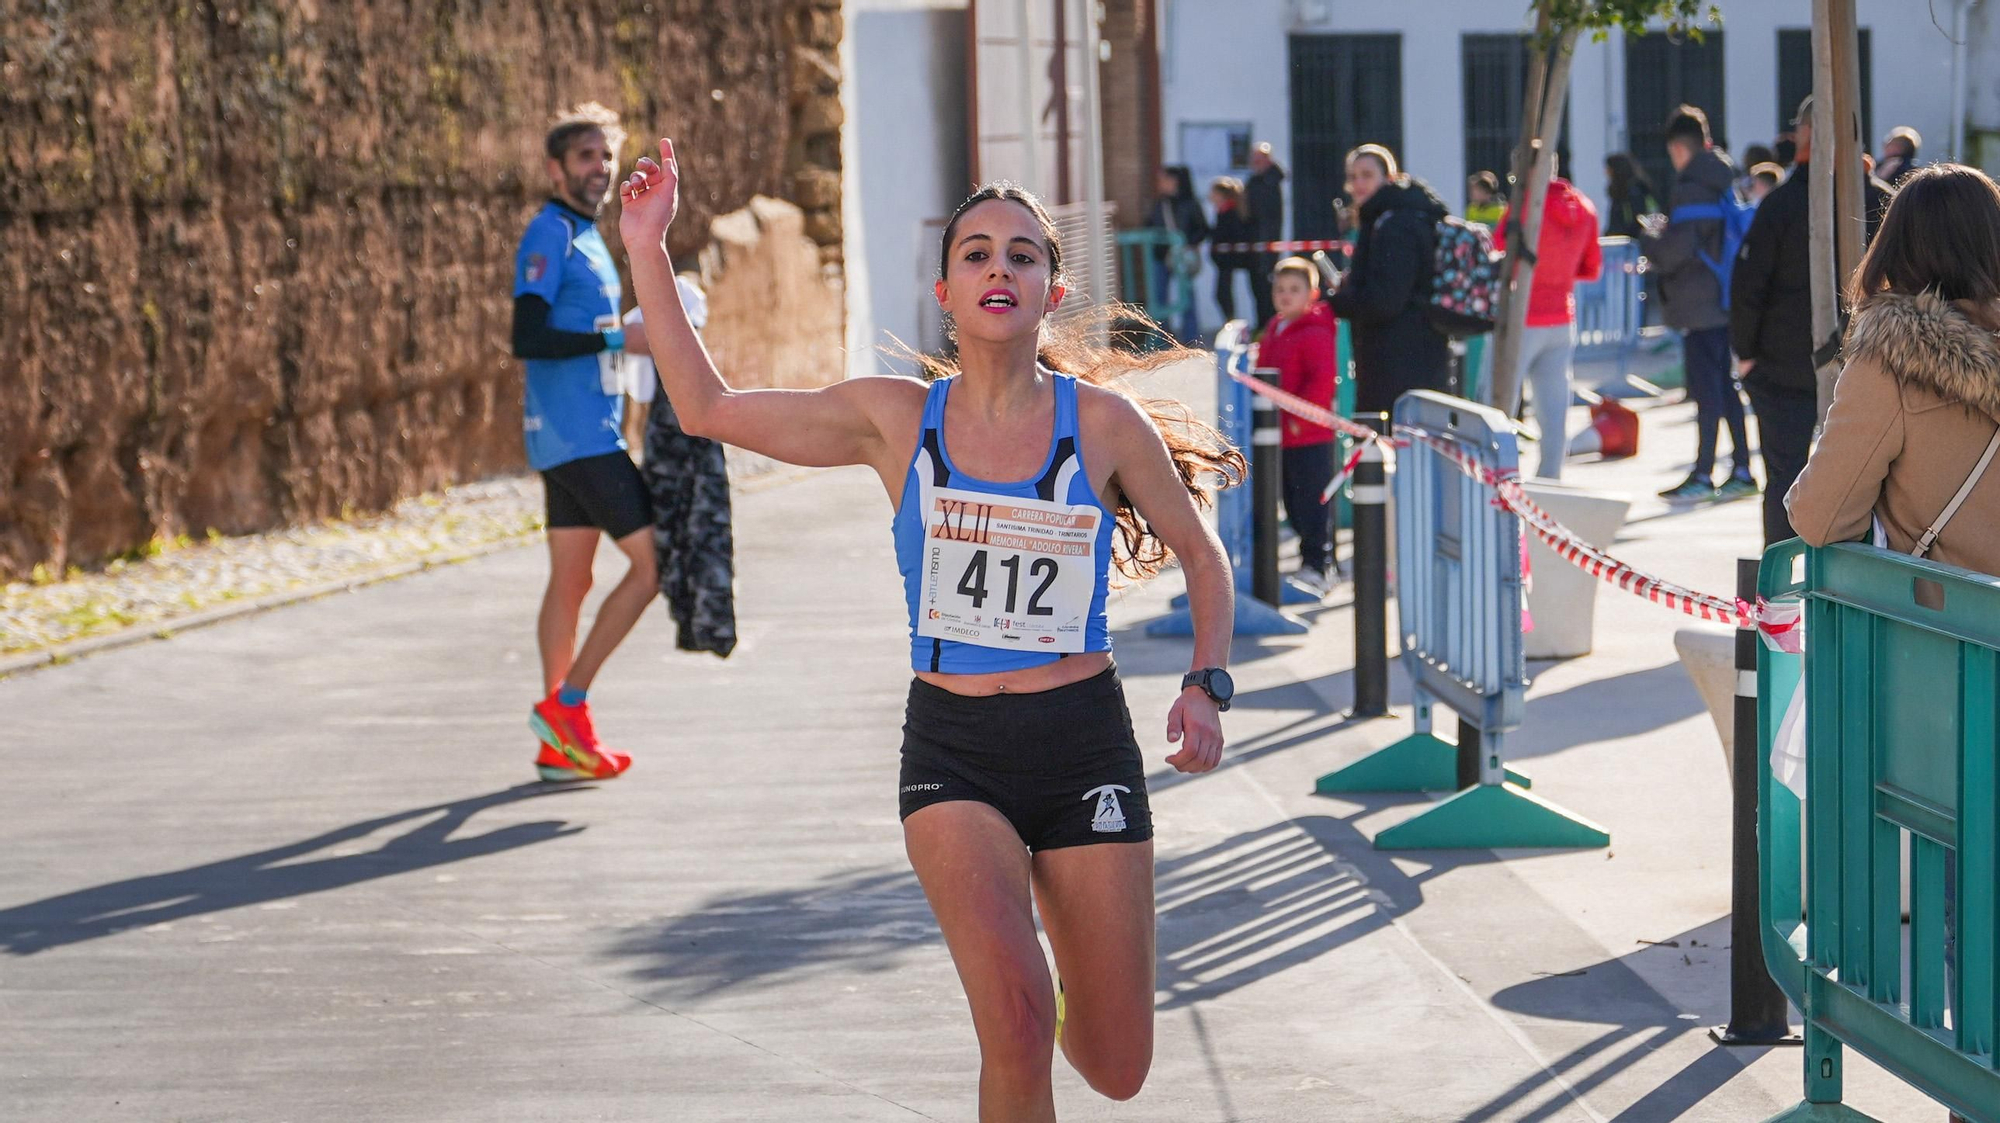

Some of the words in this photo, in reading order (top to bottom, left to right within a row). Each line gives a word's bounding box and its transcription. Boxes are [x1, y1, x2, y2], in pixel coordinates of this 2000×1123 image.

[934, 499, 994, 544] XLII
[1011, 508, 1044, 523] CARRERA
[1045, 513, 1077, 526] POPULAR
[996, 522, 1026, 532] SANTISIMA
[1027, 526, 1054, 536] TRINIDAD
[1058, 530, 1088, 538] TRINITARIOS
[989, 535, 1028, 549] MEMORIAL
[957, 549, 1059, 616] 412
[951, 626, 980, 637] IMDECO
